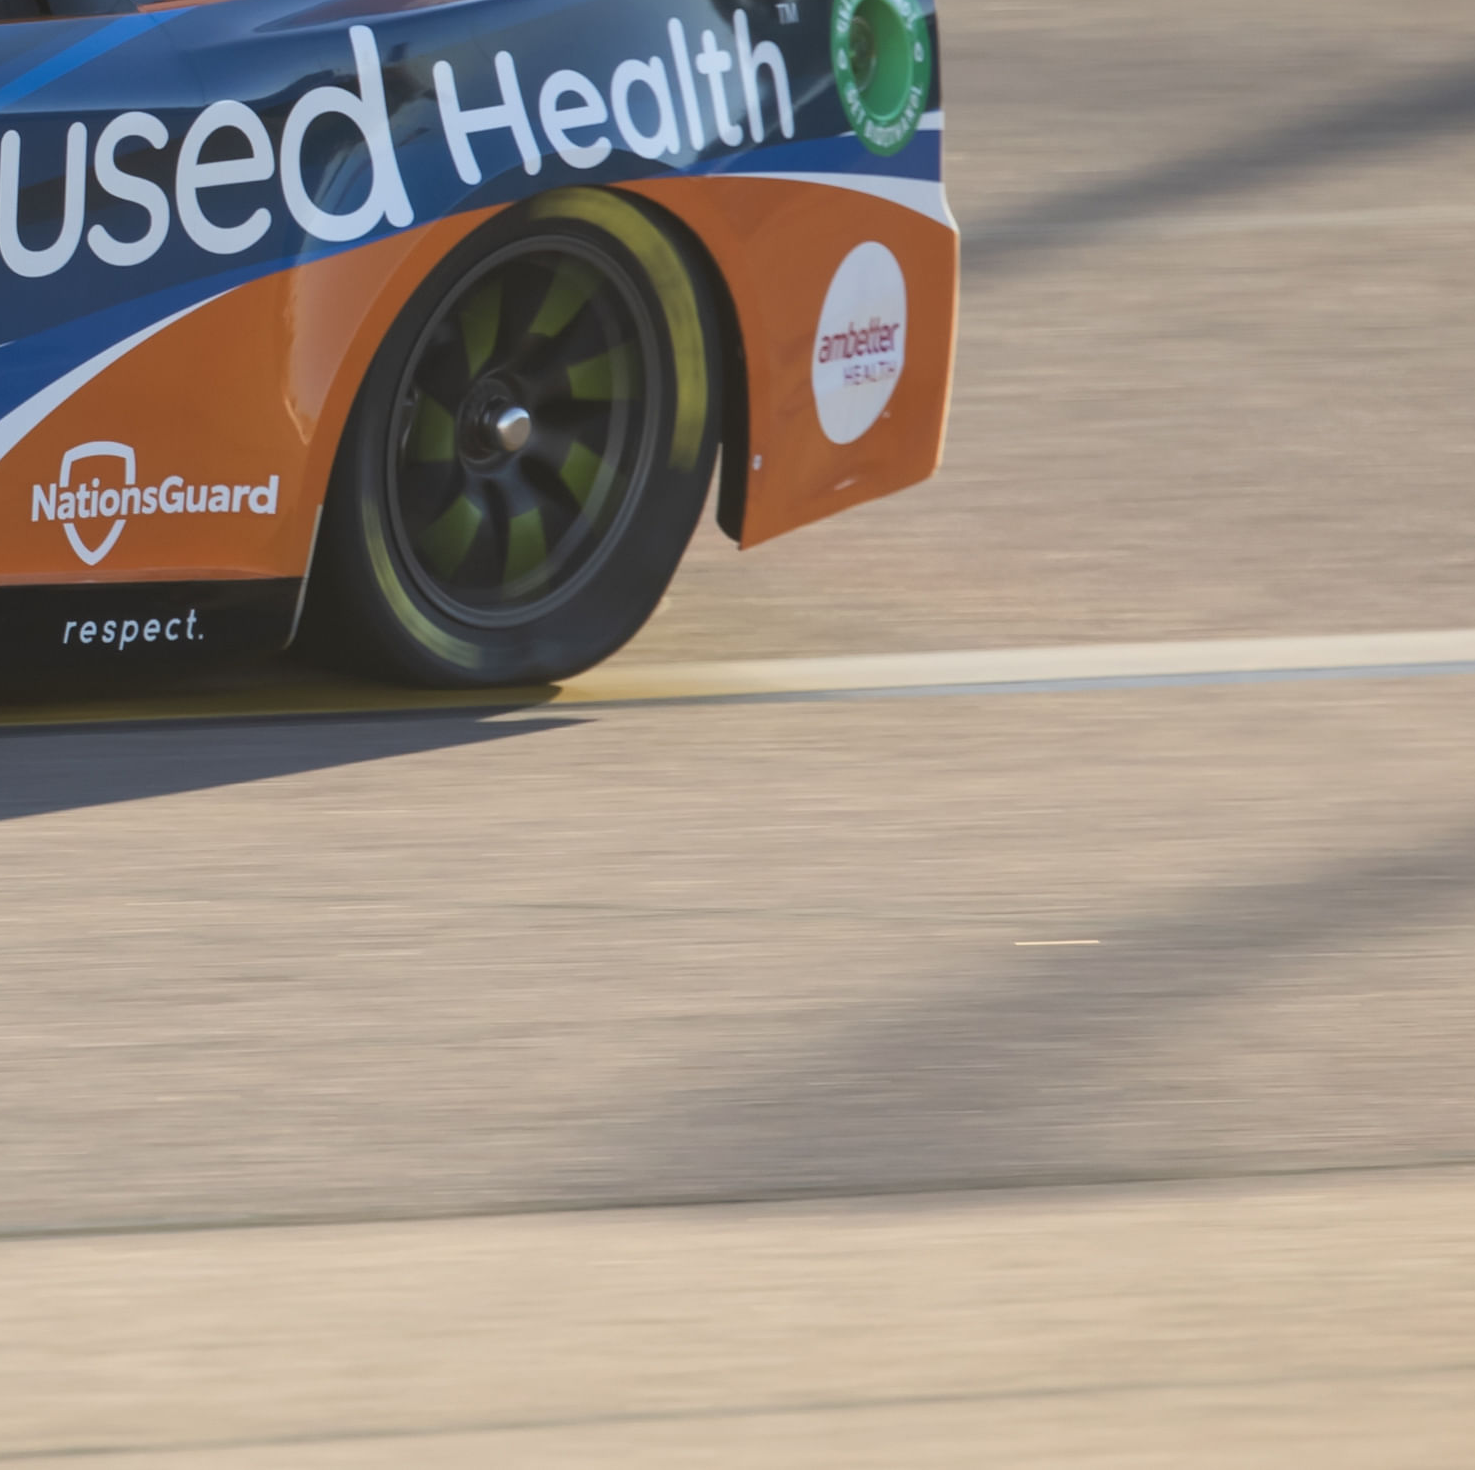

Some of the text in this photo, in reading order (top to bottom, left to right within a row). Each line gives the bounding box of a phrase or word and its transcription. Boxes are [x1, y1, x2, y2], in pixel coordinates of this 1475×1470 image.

[430, 6, 797, 187] Health
[818, 316, 901, 364] ambetter
[842, 360, 898, 387] HEALTH
[30, 474, 280, 523] NationsGuard
[62, 608, 205, 651] respect.
